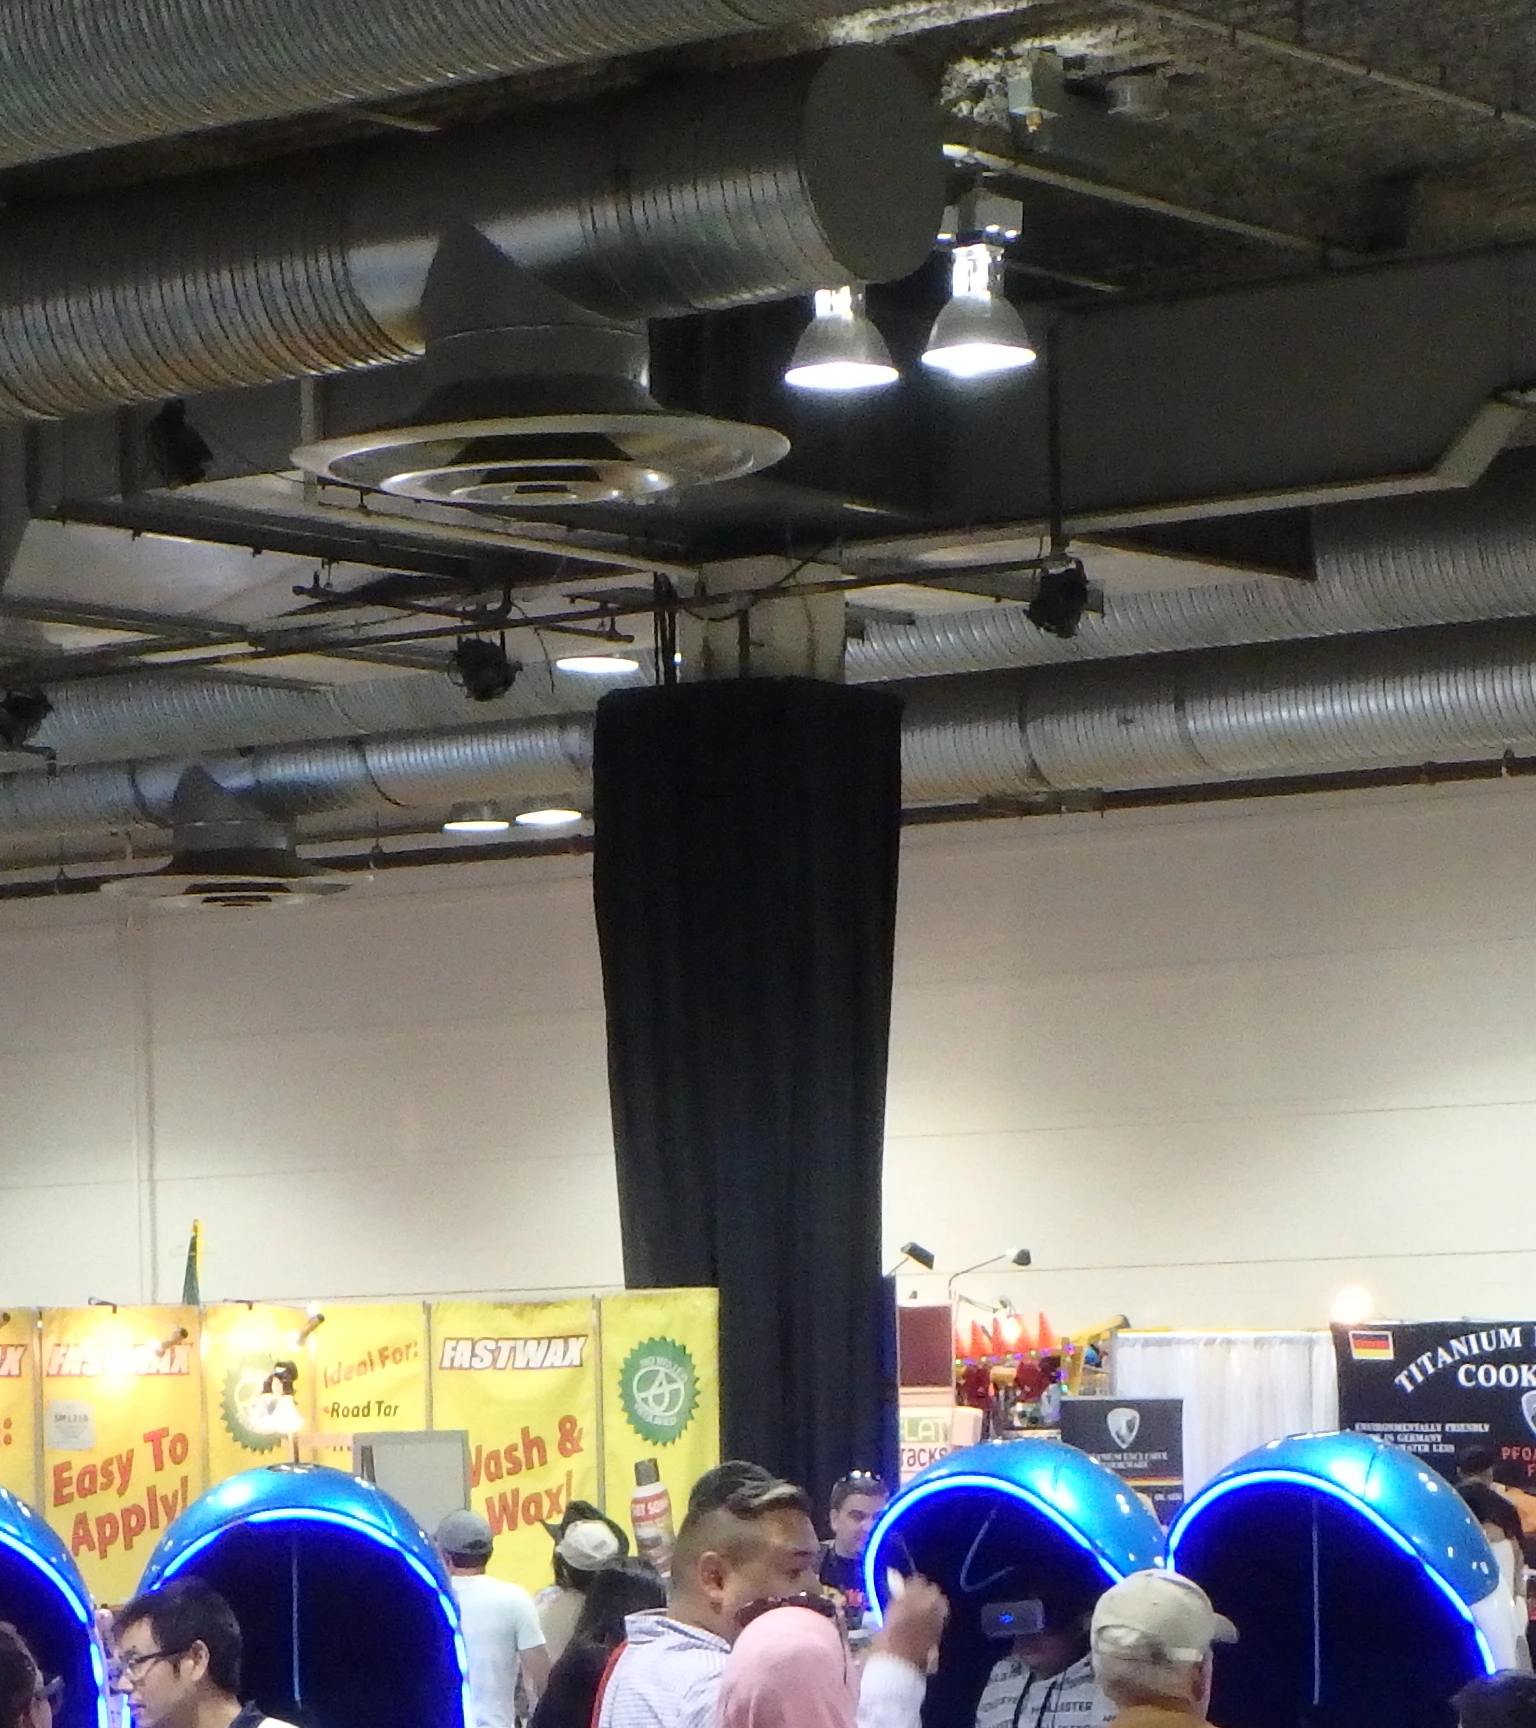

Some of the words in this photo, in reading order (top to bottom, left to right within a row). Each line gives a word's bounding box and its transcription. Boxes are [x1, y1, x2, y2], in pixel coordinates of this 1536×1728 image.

[324, 1351, 374, 1388] Ideal
[378, 1340, 419, 1368] For:
[439, 1334, 589, 1370] FASTWAX
[1394, 1326, 1522, 1393] TITANIUM
[330, 1401, 371, 1418] Road
[375, 1400, 400, 1417] Tar
[558, 1414, 584, 1458] &
[53, 1448, 135, 1507] Easy
[143, 1427, 189, 1472] To
[71, 1475, 189, 1560] Apply!
[485, 1469, 573, 1535] Wax!
